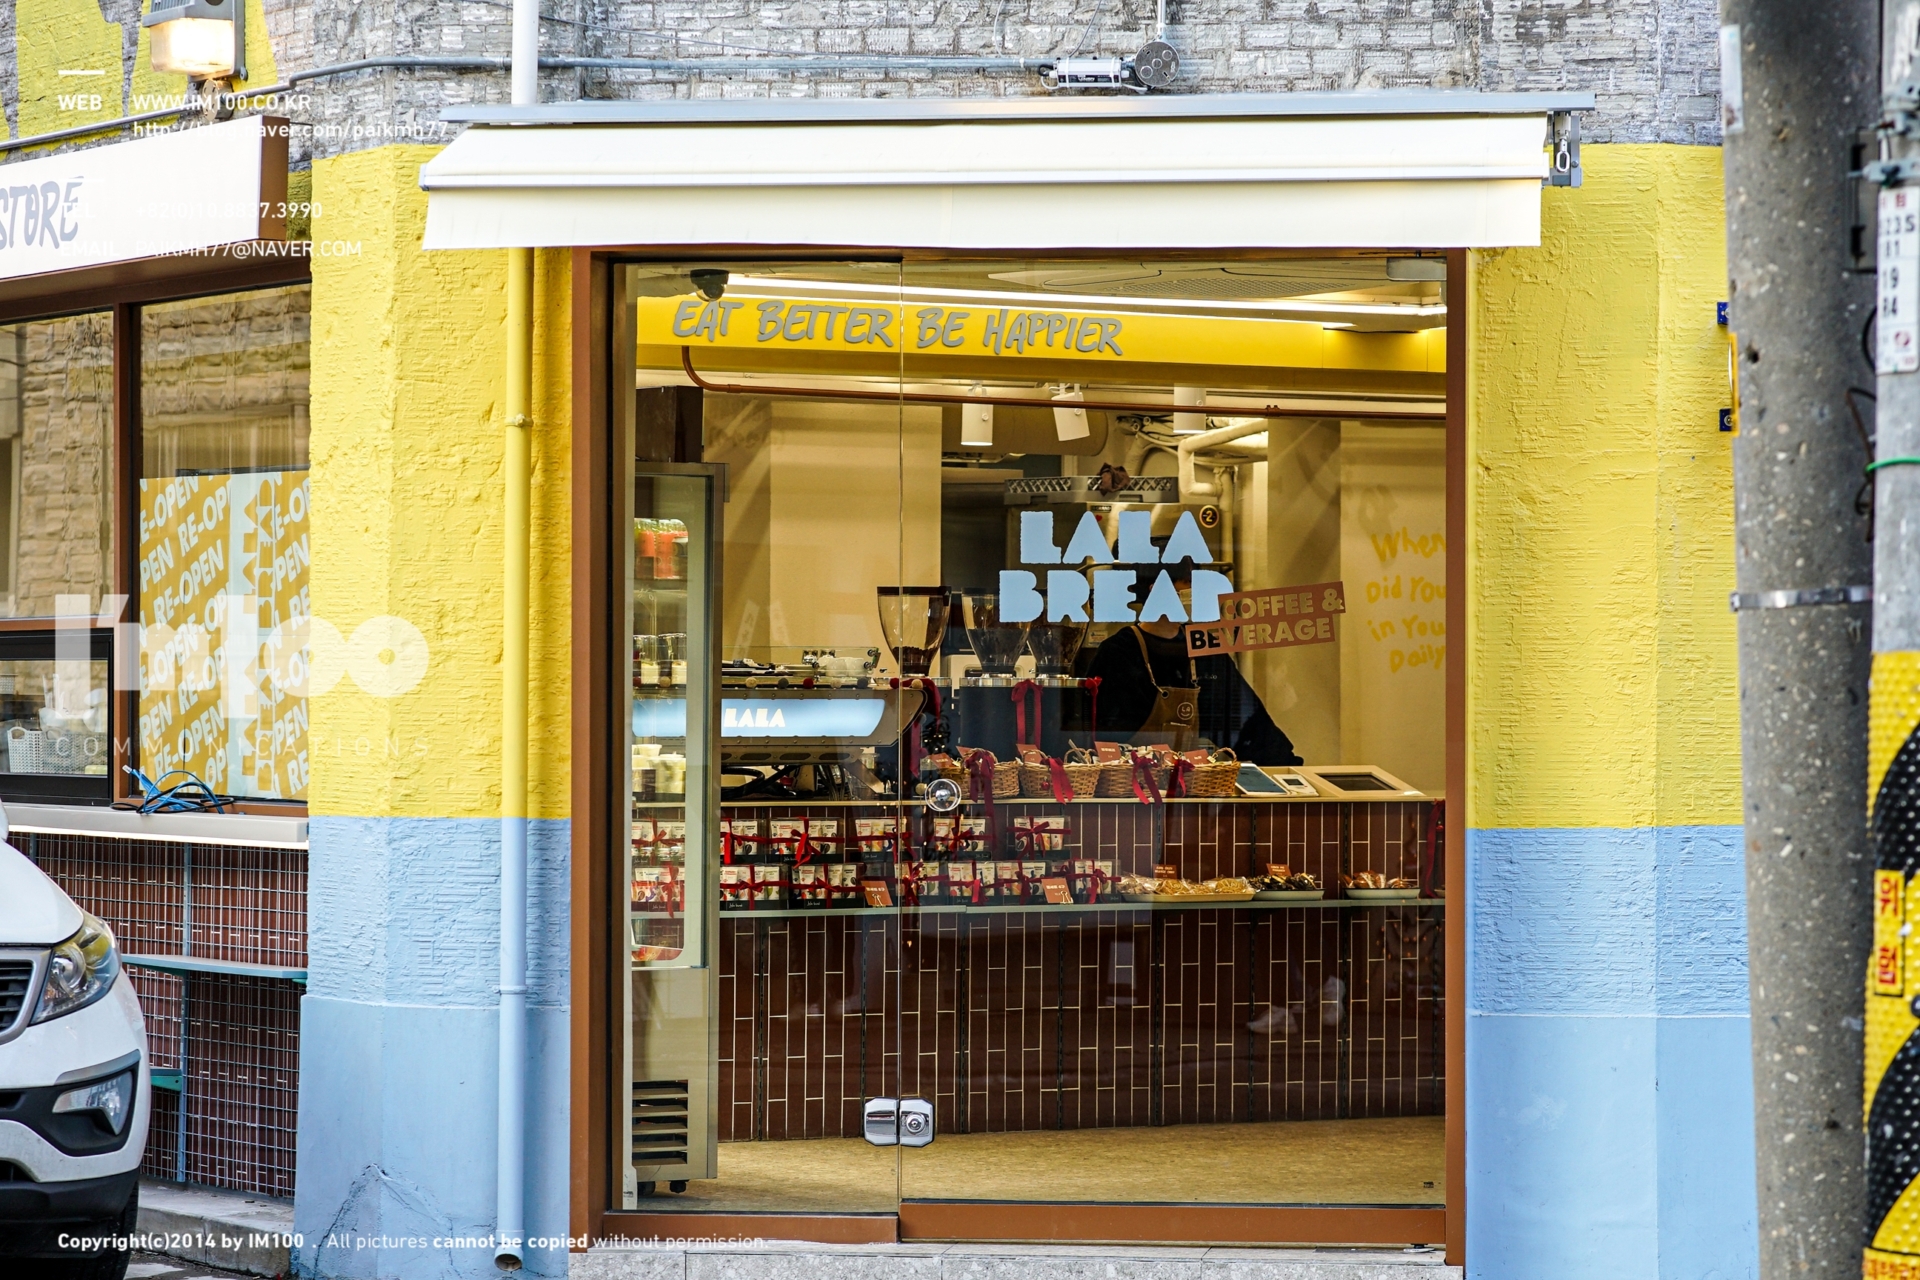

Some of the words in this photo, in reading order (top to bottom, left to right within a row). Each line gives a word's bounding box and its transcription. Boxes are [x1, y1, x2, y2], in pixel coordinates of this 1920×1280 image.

[672, 300, 743, 342] EAT
[757, 301, 894, 347] BETTER
[917, 307, 969, 348] BE
[983, 309, 1124, 356] HAPPIER
[1019, 510, 1214, 564] LALA
[999, 569, 1235, 623] BREAD
[1220, 592, 1314, 620] COFFEE
[1322, 588, 1344, 612] &
[1366, 574, 1402, 604] Did
[1189, 617, 1331, 650] BEVERAGE
[1389, 643, 1446, 674] Daily
[723, 708, 786, 728] LALA
